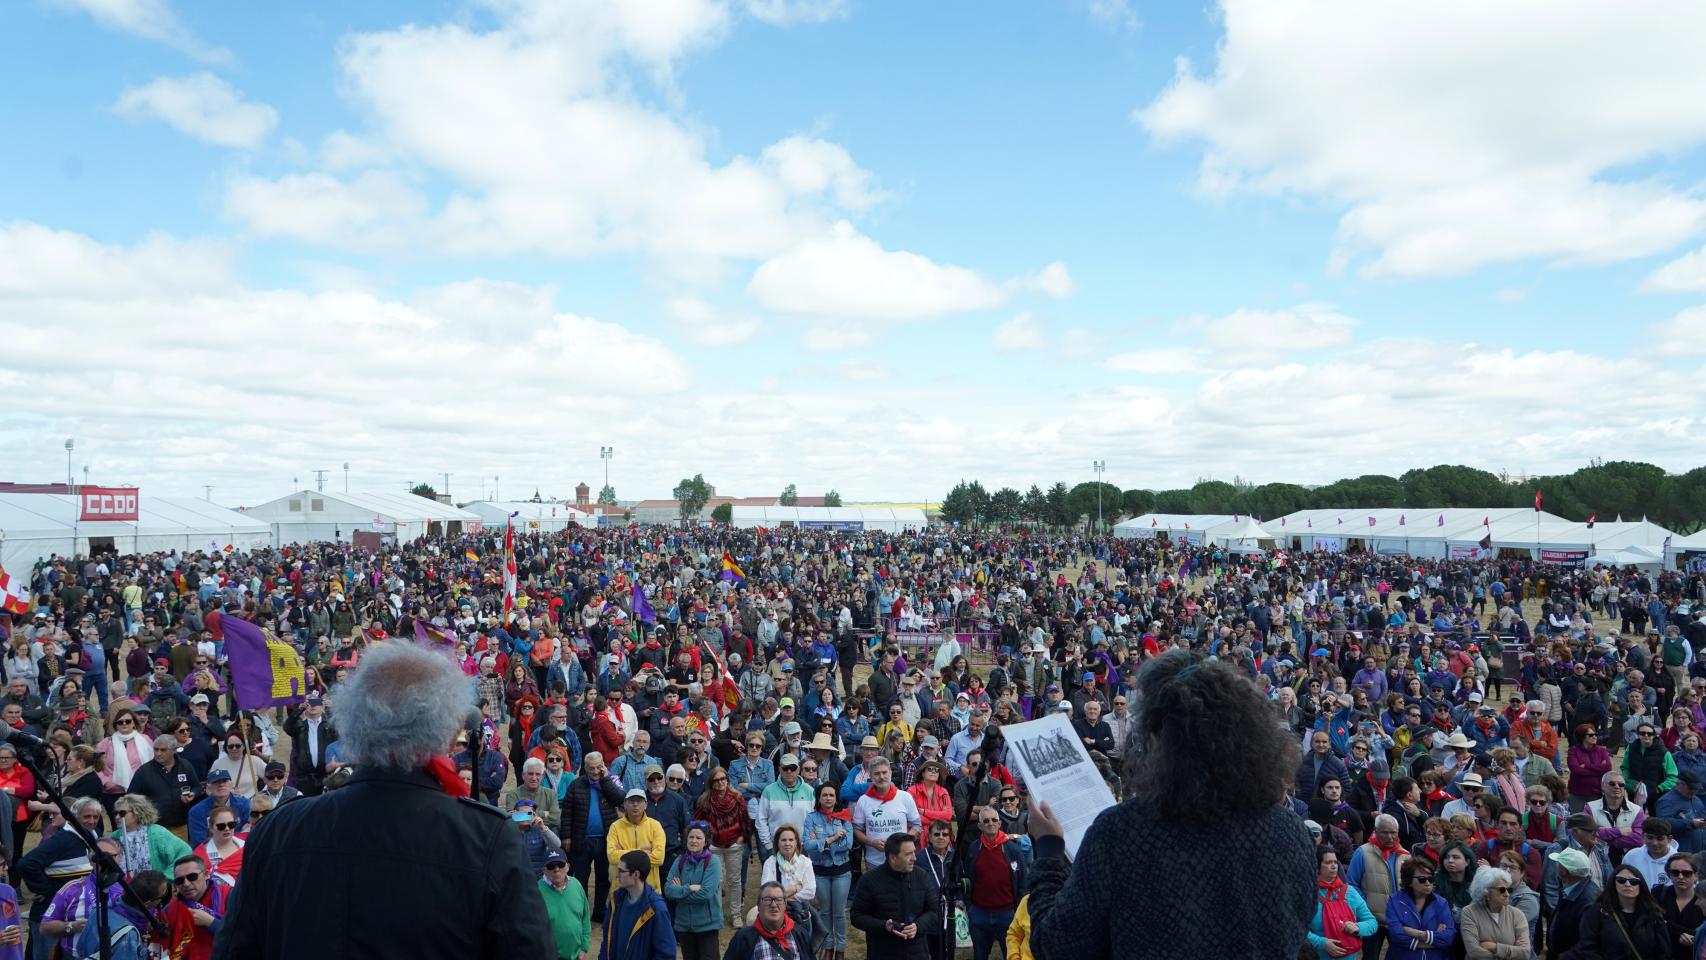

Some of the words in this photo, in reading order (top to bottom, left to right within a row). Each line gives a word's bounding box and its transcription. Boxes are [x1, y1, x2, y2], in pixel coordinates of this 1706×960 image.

[86, 494, 136, 514] CCOO
[880, 819, 887, 827] LA
[887, 818, 901, 826] MINA
